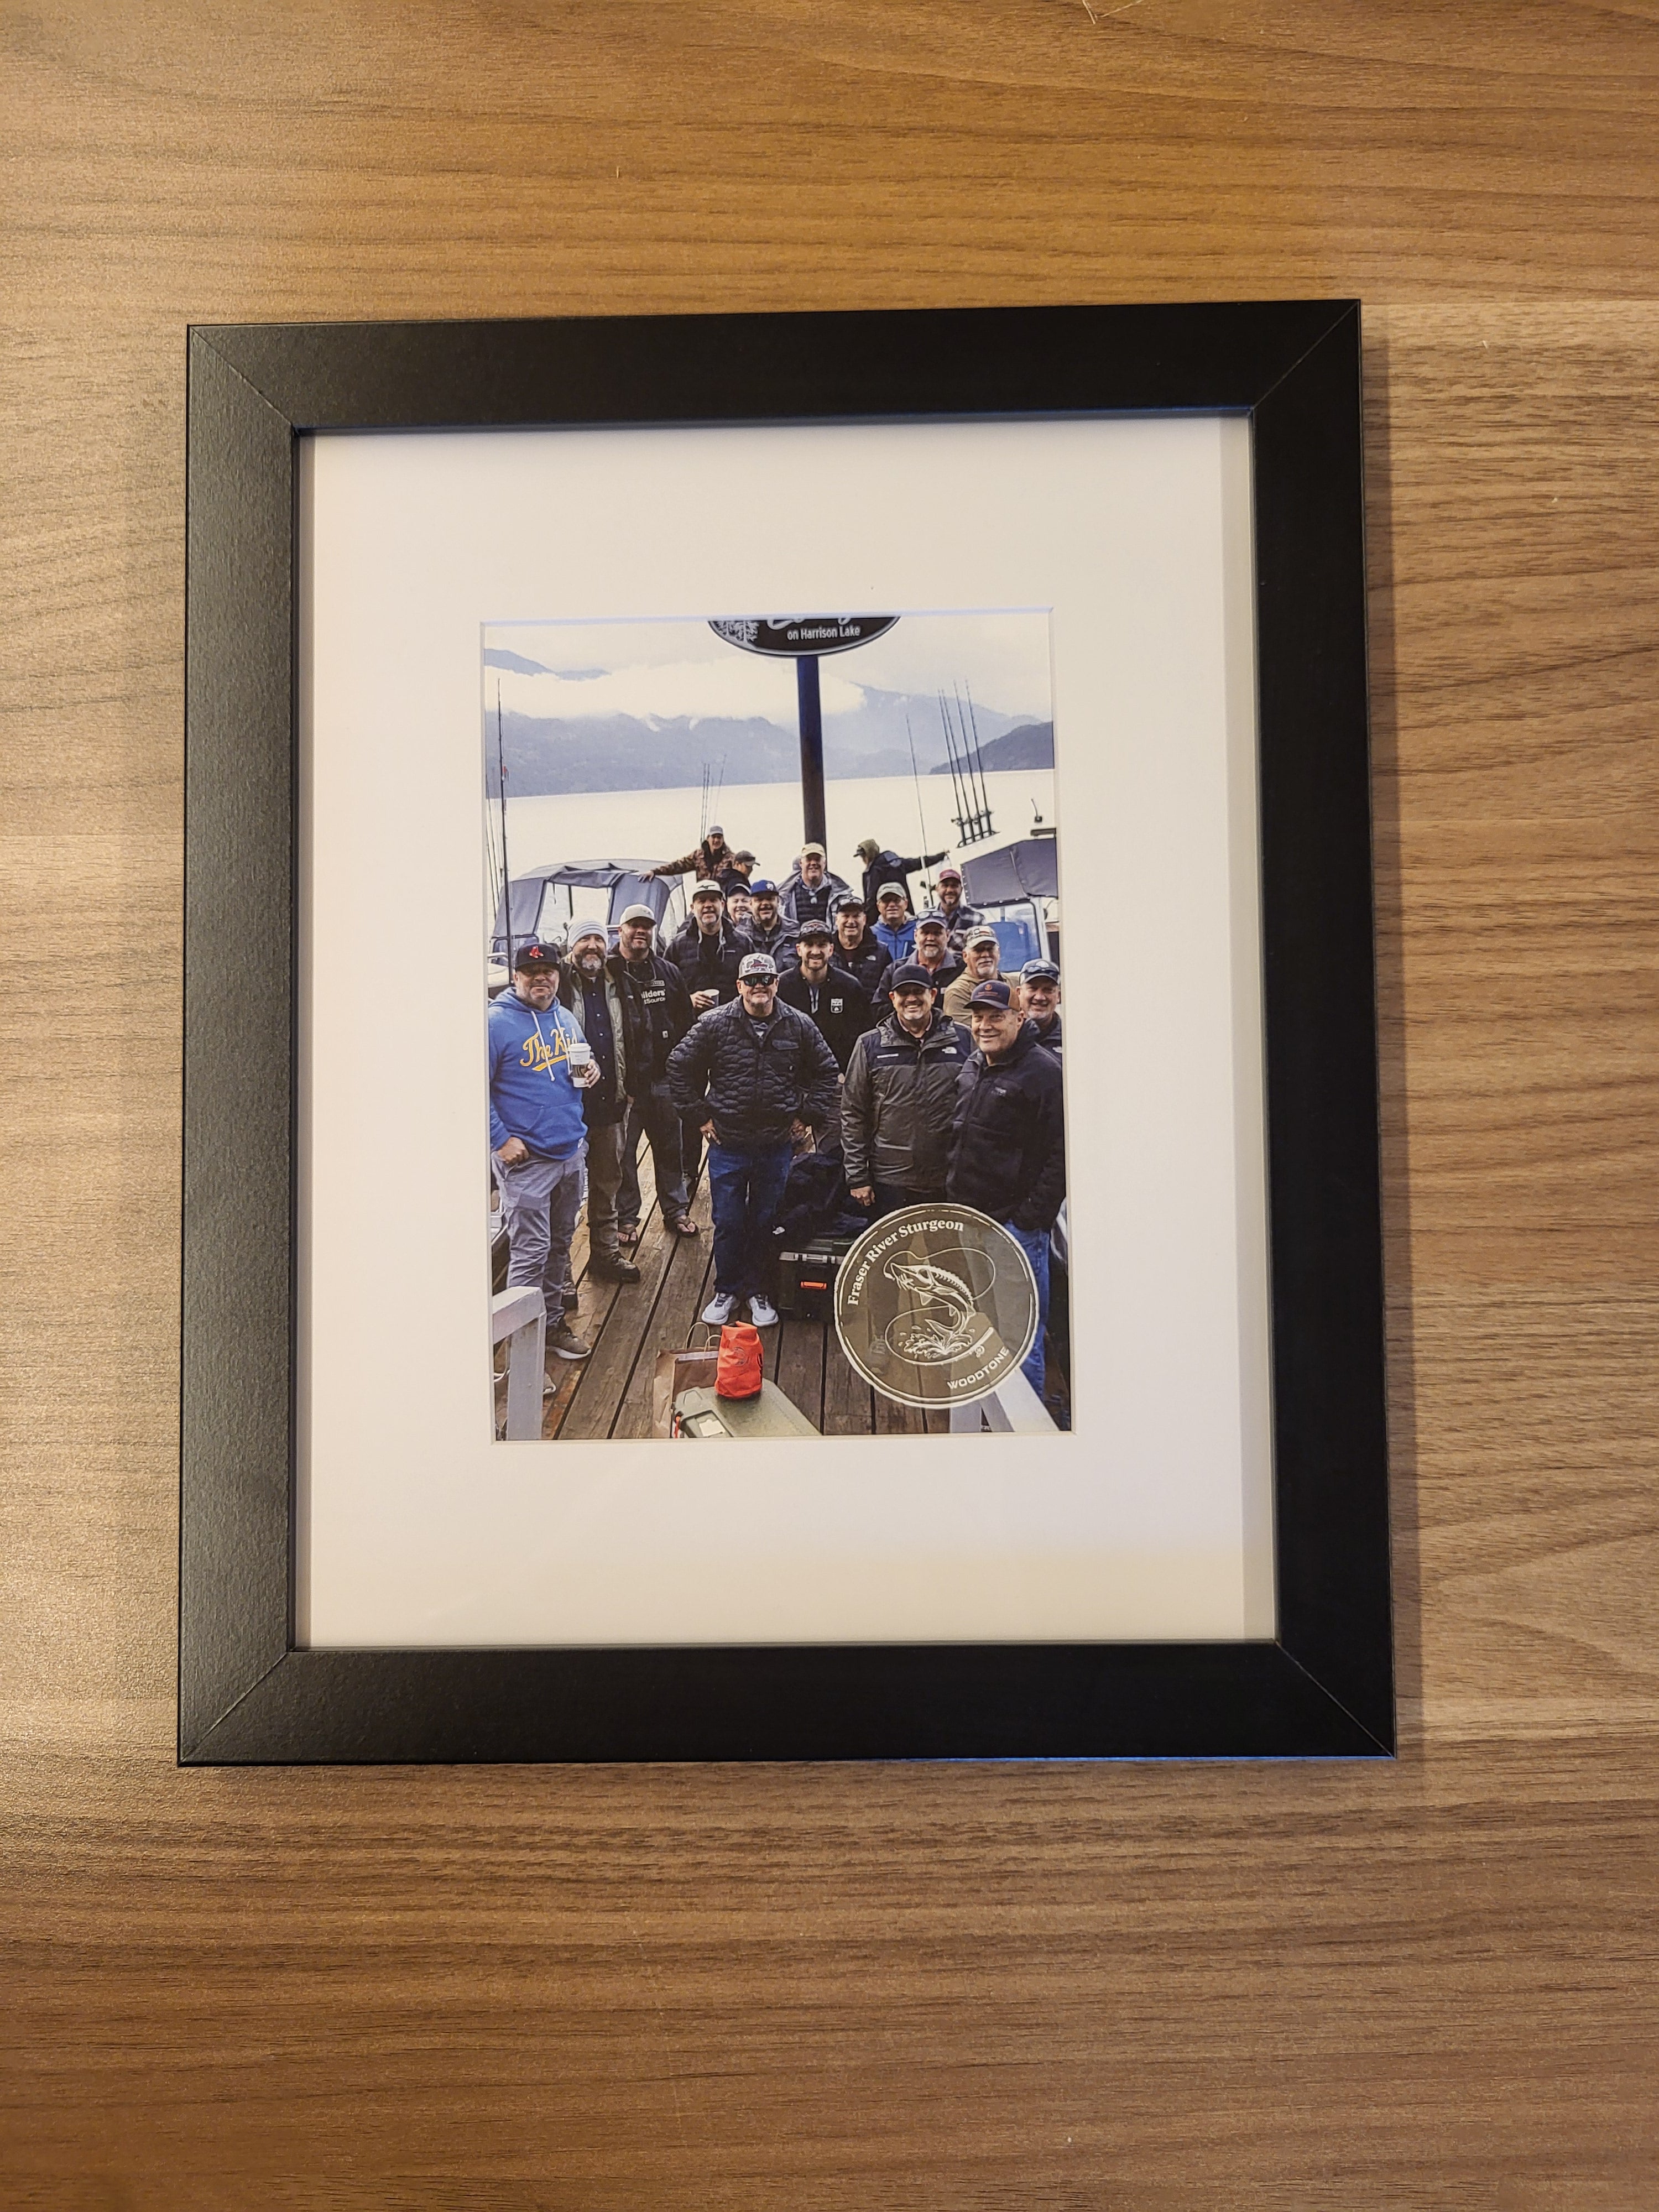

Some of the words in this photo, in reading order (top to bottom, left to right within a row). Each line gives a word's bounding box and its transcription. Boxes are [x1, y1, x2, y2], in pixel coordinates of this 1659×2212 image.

[787, 629, 799, 640] on
[800, 625, 838, 640] Harrison
[839, 625, 860, 638] Lake
[520, 1031, 554, 1067] The
[847, 1260, 871, 1306] Fraser
[865, 1231, 899, 1263] River
[898, 1219, 964, 1238] Sturgeon
[946, 1345, 1010, 1390] WOODTONE
